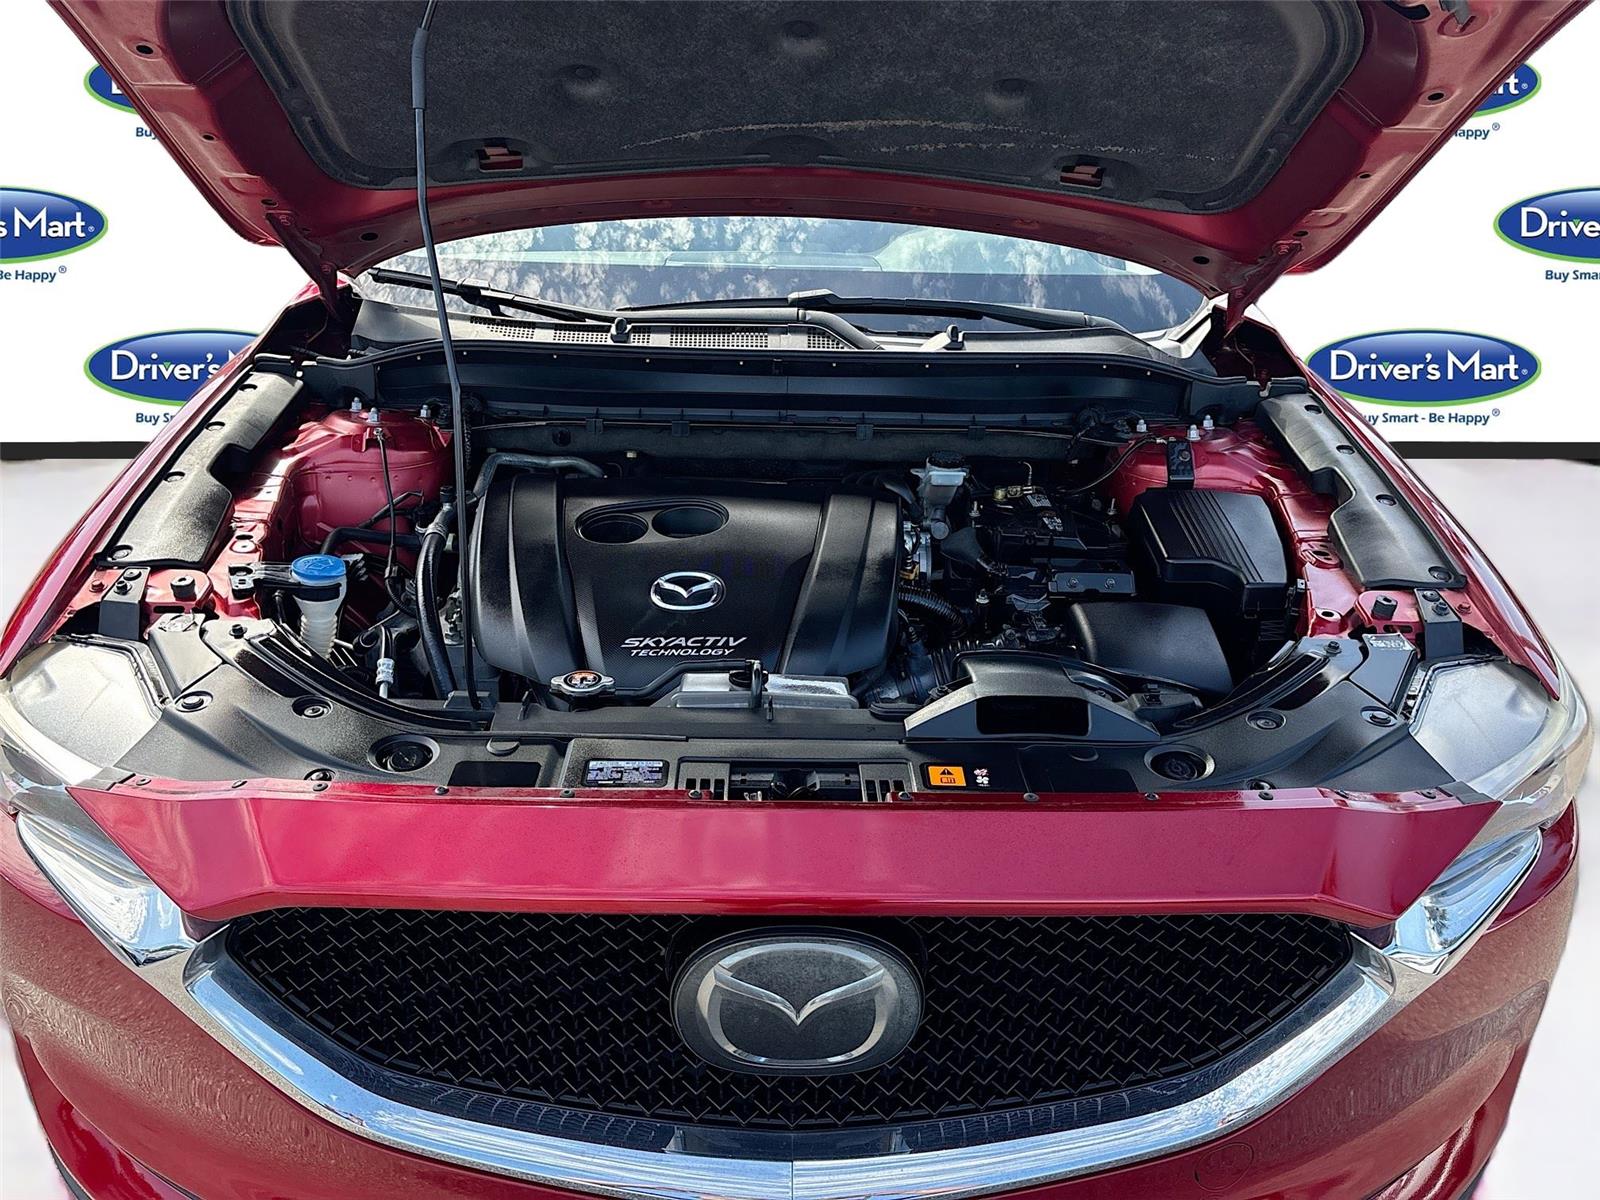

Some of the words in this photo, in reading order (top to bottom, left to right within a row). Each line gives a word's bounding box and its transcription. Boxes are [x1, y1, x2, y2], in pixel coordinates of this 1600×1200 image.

[1454, 129, 1490, 140] appy
[1545, 269, 1570, 283] Buy
[1572, 269, 1600, 280] Sma
[1330, 349, 1441, 381] Driver's
[136, 412, 160, 426] Buy
[1382, 412, 1419, 423] Smart
[1428, 412, 1445, 423] Be
[620, 636, 748, 648] SKYACTIV
[630, 648, 735, 657] TECHNOLOGY
